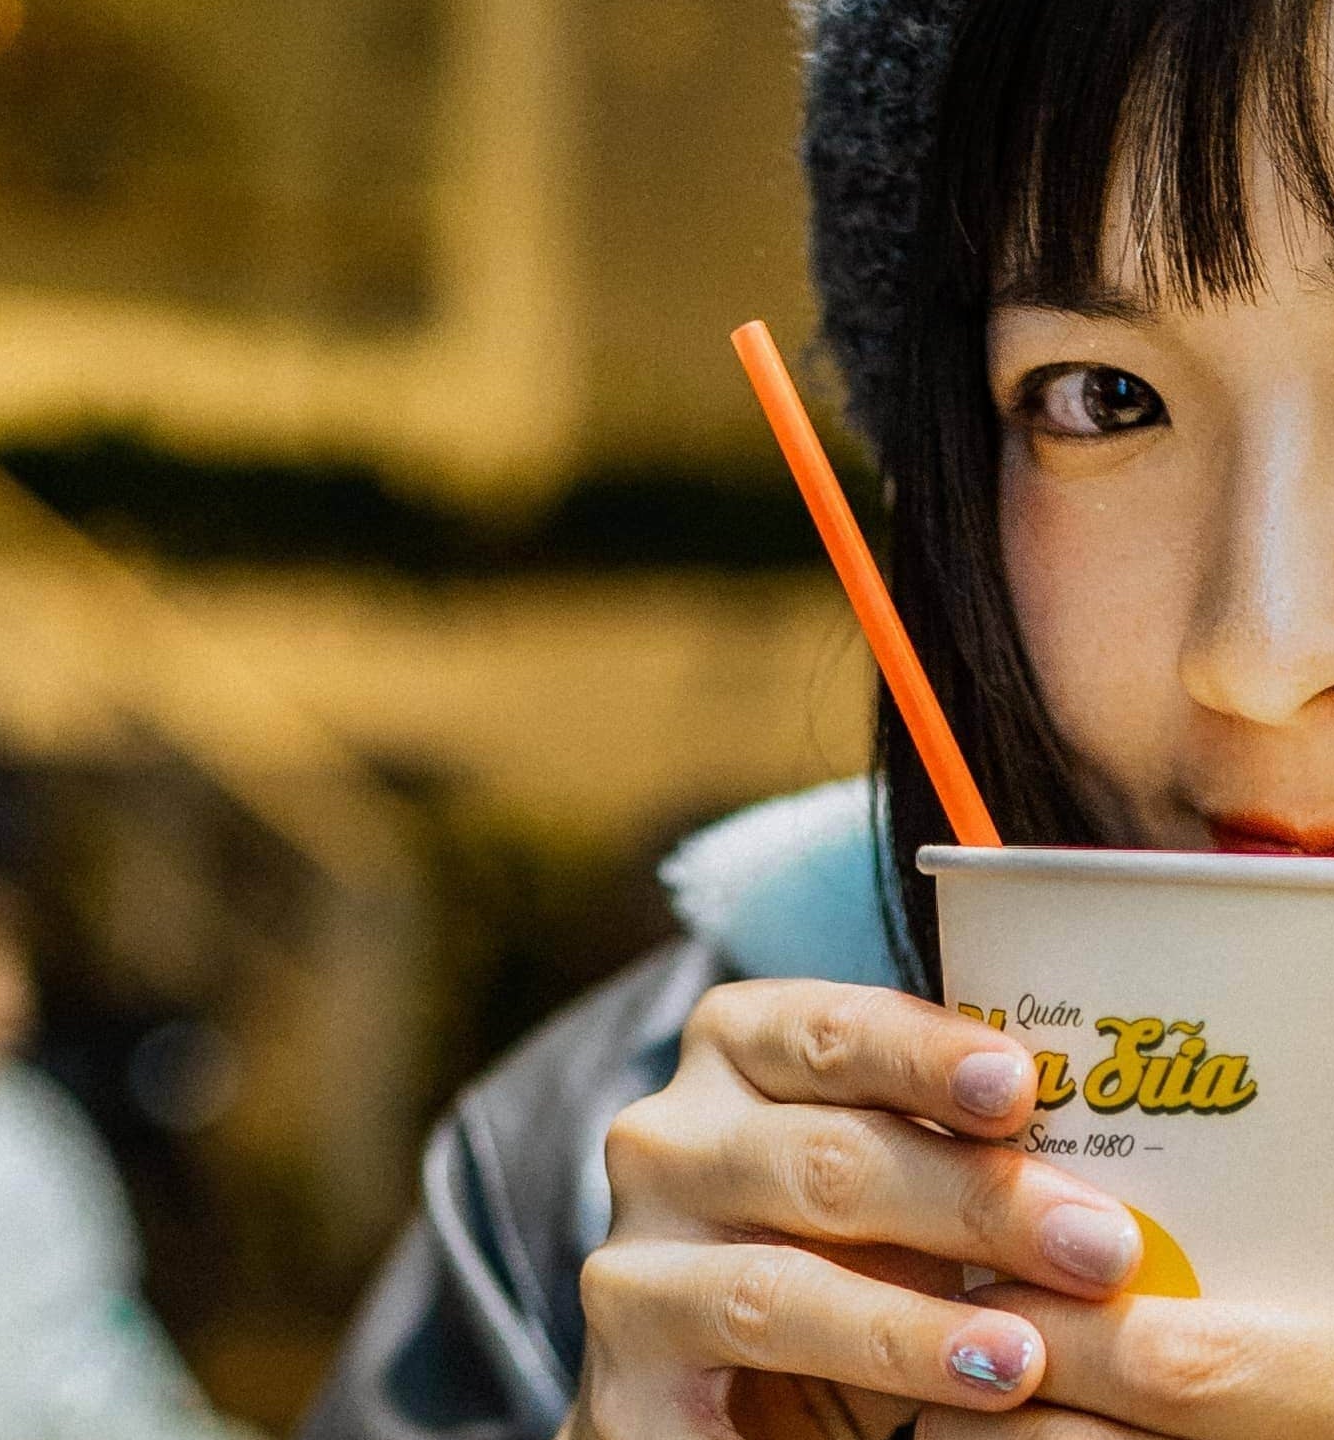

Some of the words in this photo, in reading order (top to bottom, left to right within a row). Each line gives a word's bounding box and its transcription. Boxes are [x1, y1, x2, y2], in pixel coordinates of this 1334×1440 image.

[1016, 993, 1084, 1030] Quán
[1083, 1016, 1257, 1115] Sữa
[1024, 1123, 1078, 1155] Since
[1083, 1133, 1136, 1158] 1980
